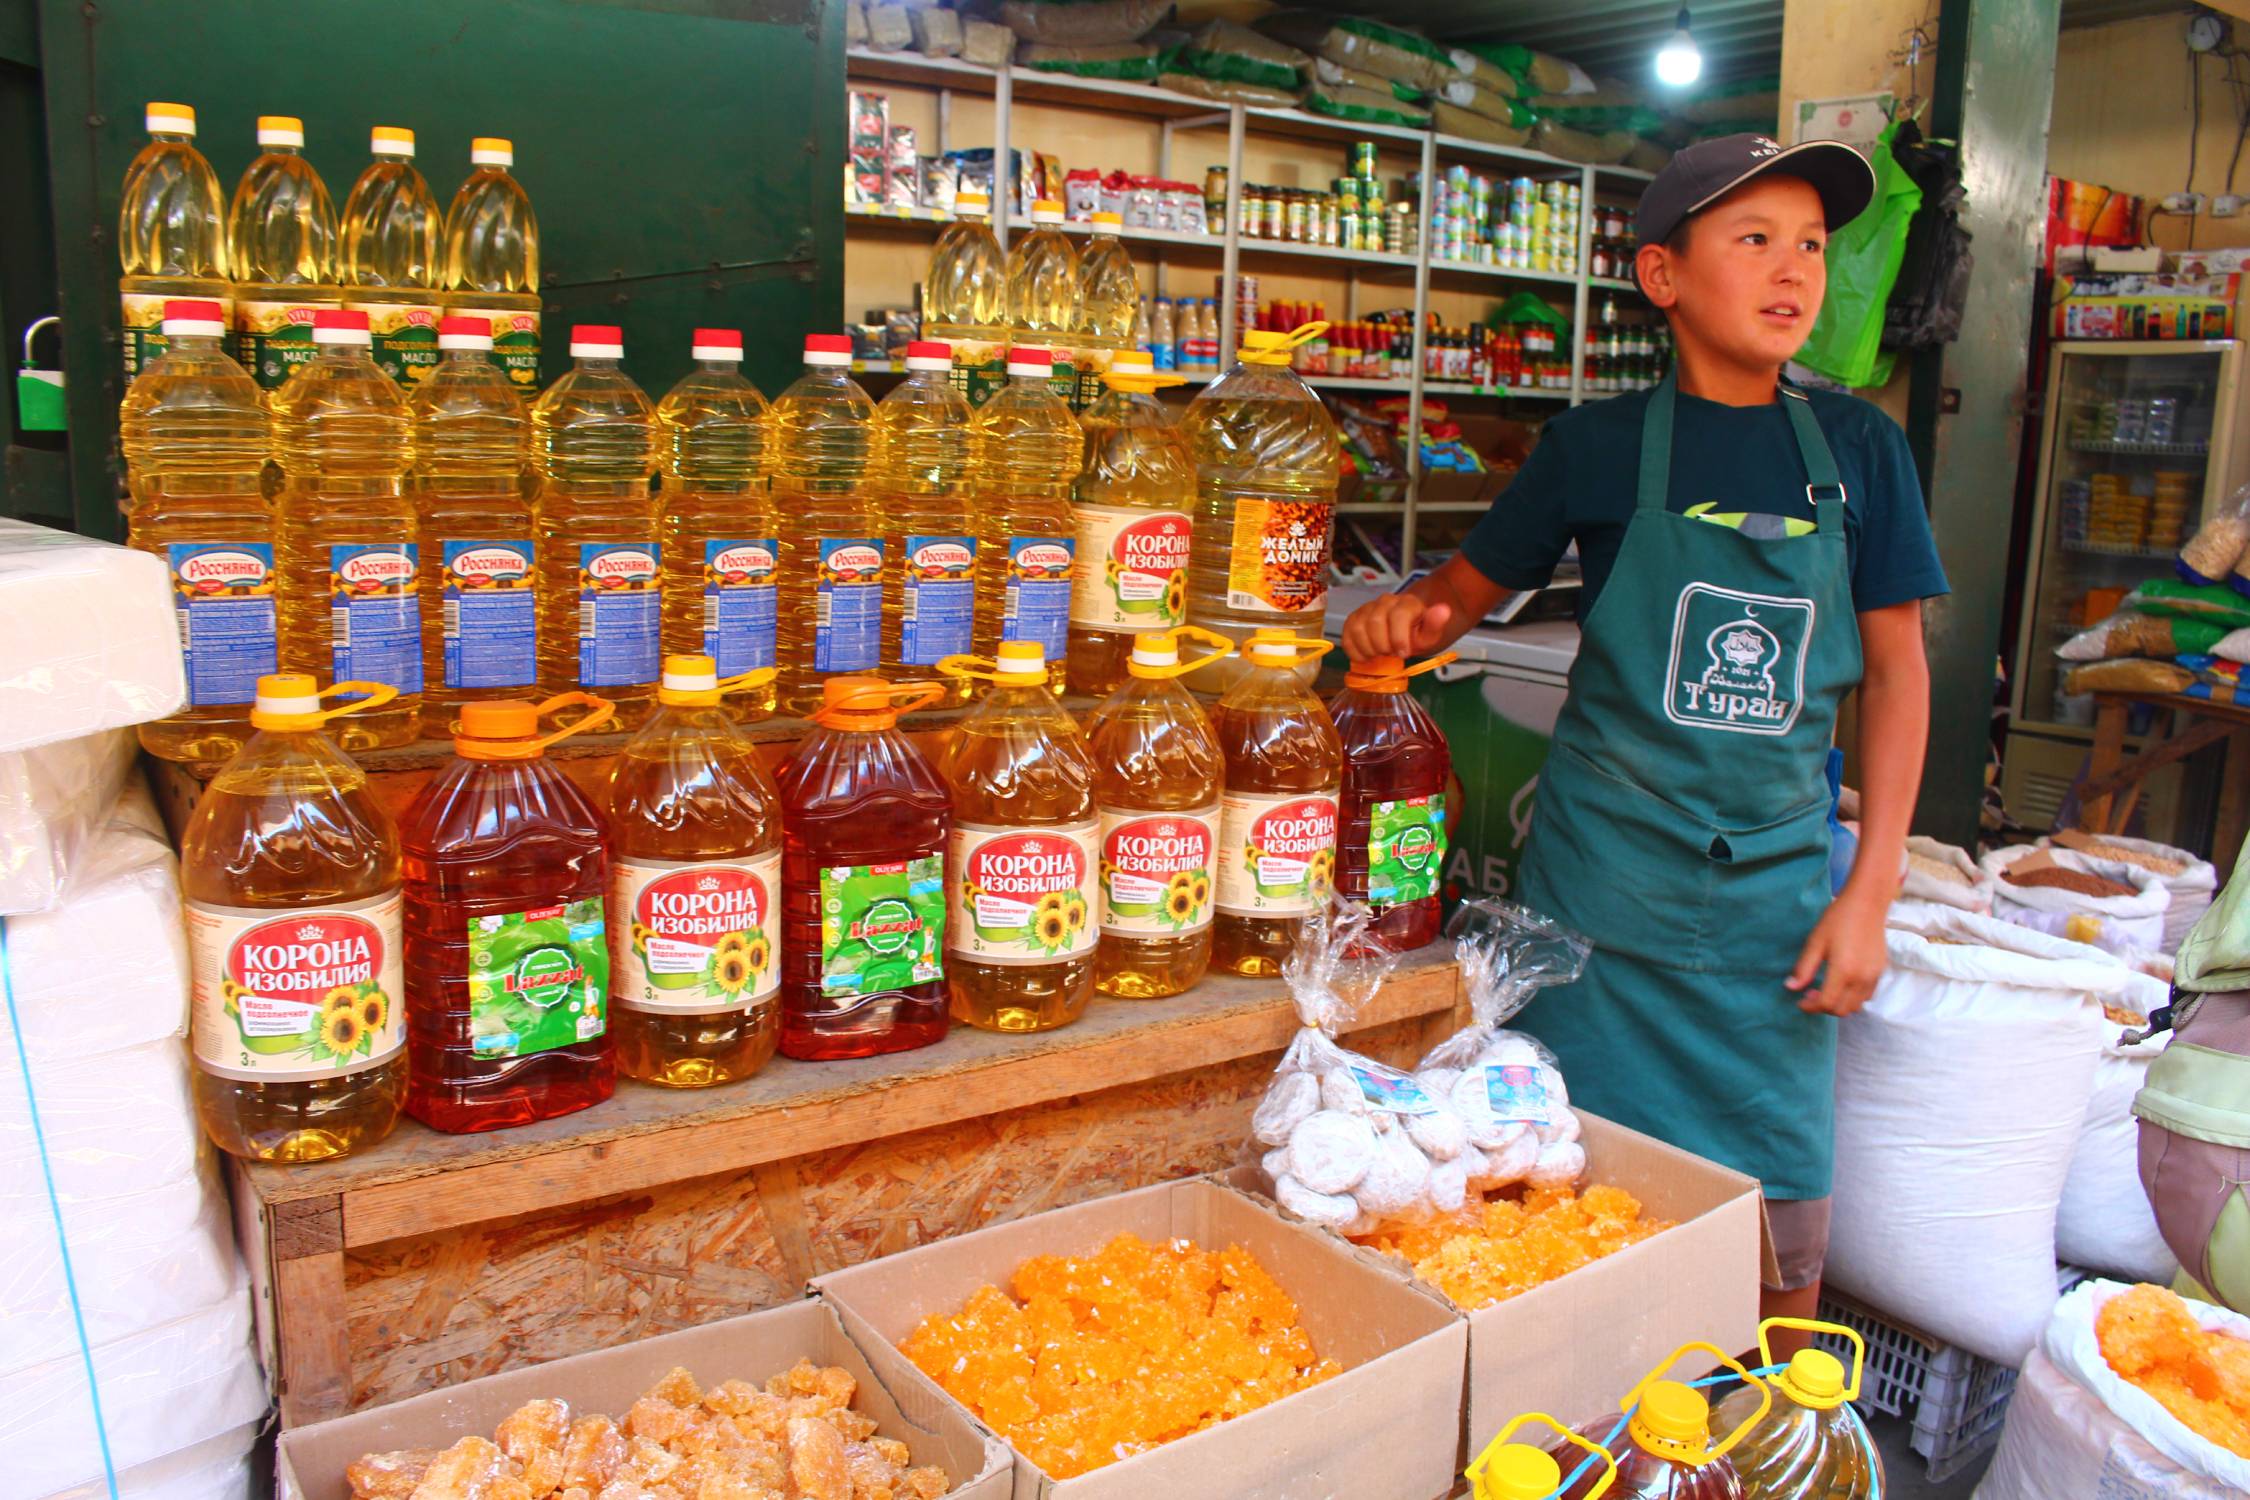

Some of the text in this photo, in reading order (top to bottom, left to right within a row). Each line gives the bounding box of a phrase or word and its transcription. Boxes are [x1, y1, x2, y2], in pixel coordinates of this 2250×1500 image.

[1260, 535, 1324, 550] ЖЕЛТЫЙ
[1264, 550, 1319, 564] ДОМИК
[1114, 611, 1121, 622] 3
[1683, 681, 1788, 720] Туран
[1264, 815, 1335, 840] КОРОНА
[1117, 834, 1204, 857] КОРОНА
[980, 853, 1076, 876] КОРОНА
[1116, 853, 1204, 872] ИЗОБИЛИЯ
[980, 872, 1076, 892] ИЗОБИЛИЯ
[651, 887, 757, 916] КОРОНА
[1254, 897, 1261, 907] 3
[651, 910, 758, 934] ИЗОБИЛИЯ
[850, 916, 923, 938] Lazzat
[1106, 913, 1113, 924] 3
[243, 935, 371, 972] КОРОНА
[973, 939, 980, 950] 3
[244, 961, 372, 992] ИЗОБИЛИЯ
[504, 962, 584, 993] Lazzat
[645, 986, 652, 1000] 3
[240, 1051, 249, 1067] 3
